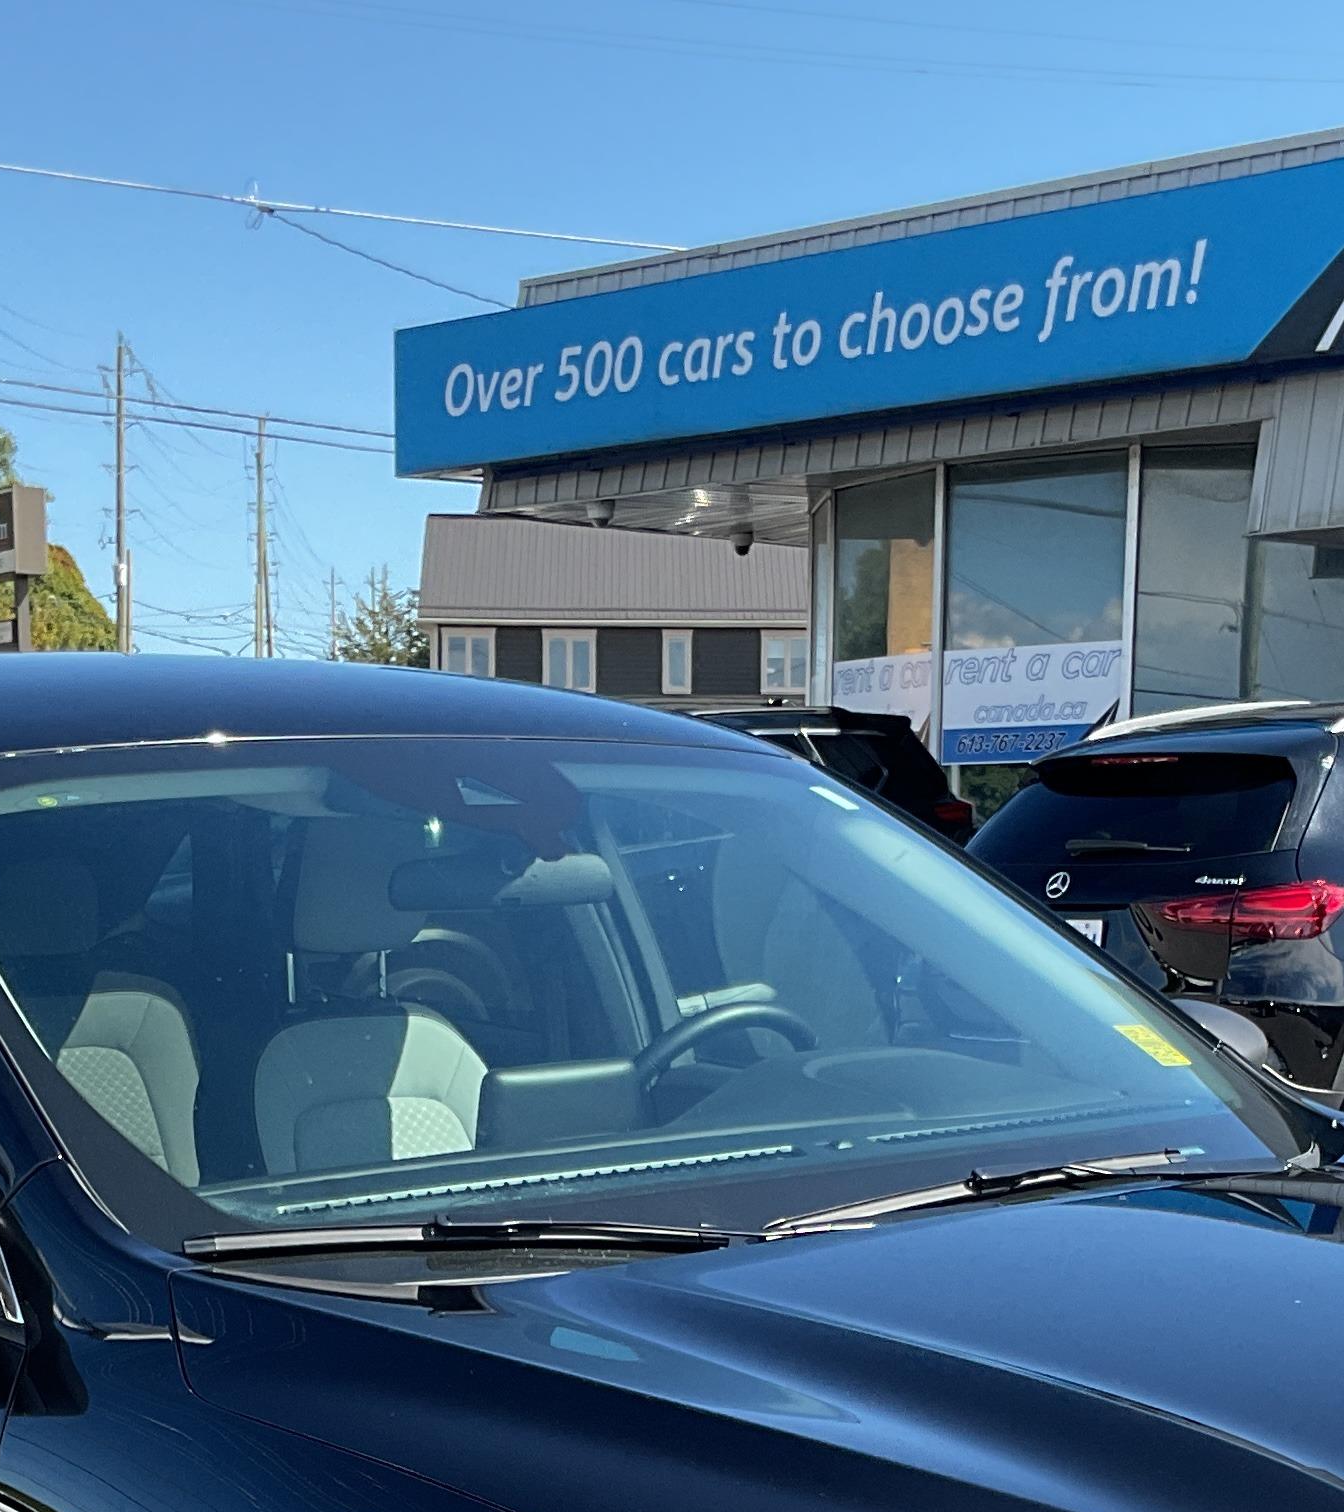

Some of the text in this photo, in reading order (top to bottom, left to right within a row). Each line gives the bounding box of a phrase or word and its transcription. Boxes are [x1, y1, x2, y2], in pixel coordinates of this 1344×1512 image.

[444, 238, 1208, 417] Over 500 cars to choose from!
[944, 647, 1123, 686] rent a car
[973, 695, 1089, 724] canada.ca
[956, 732, 1068, 754] 613-767-2237
